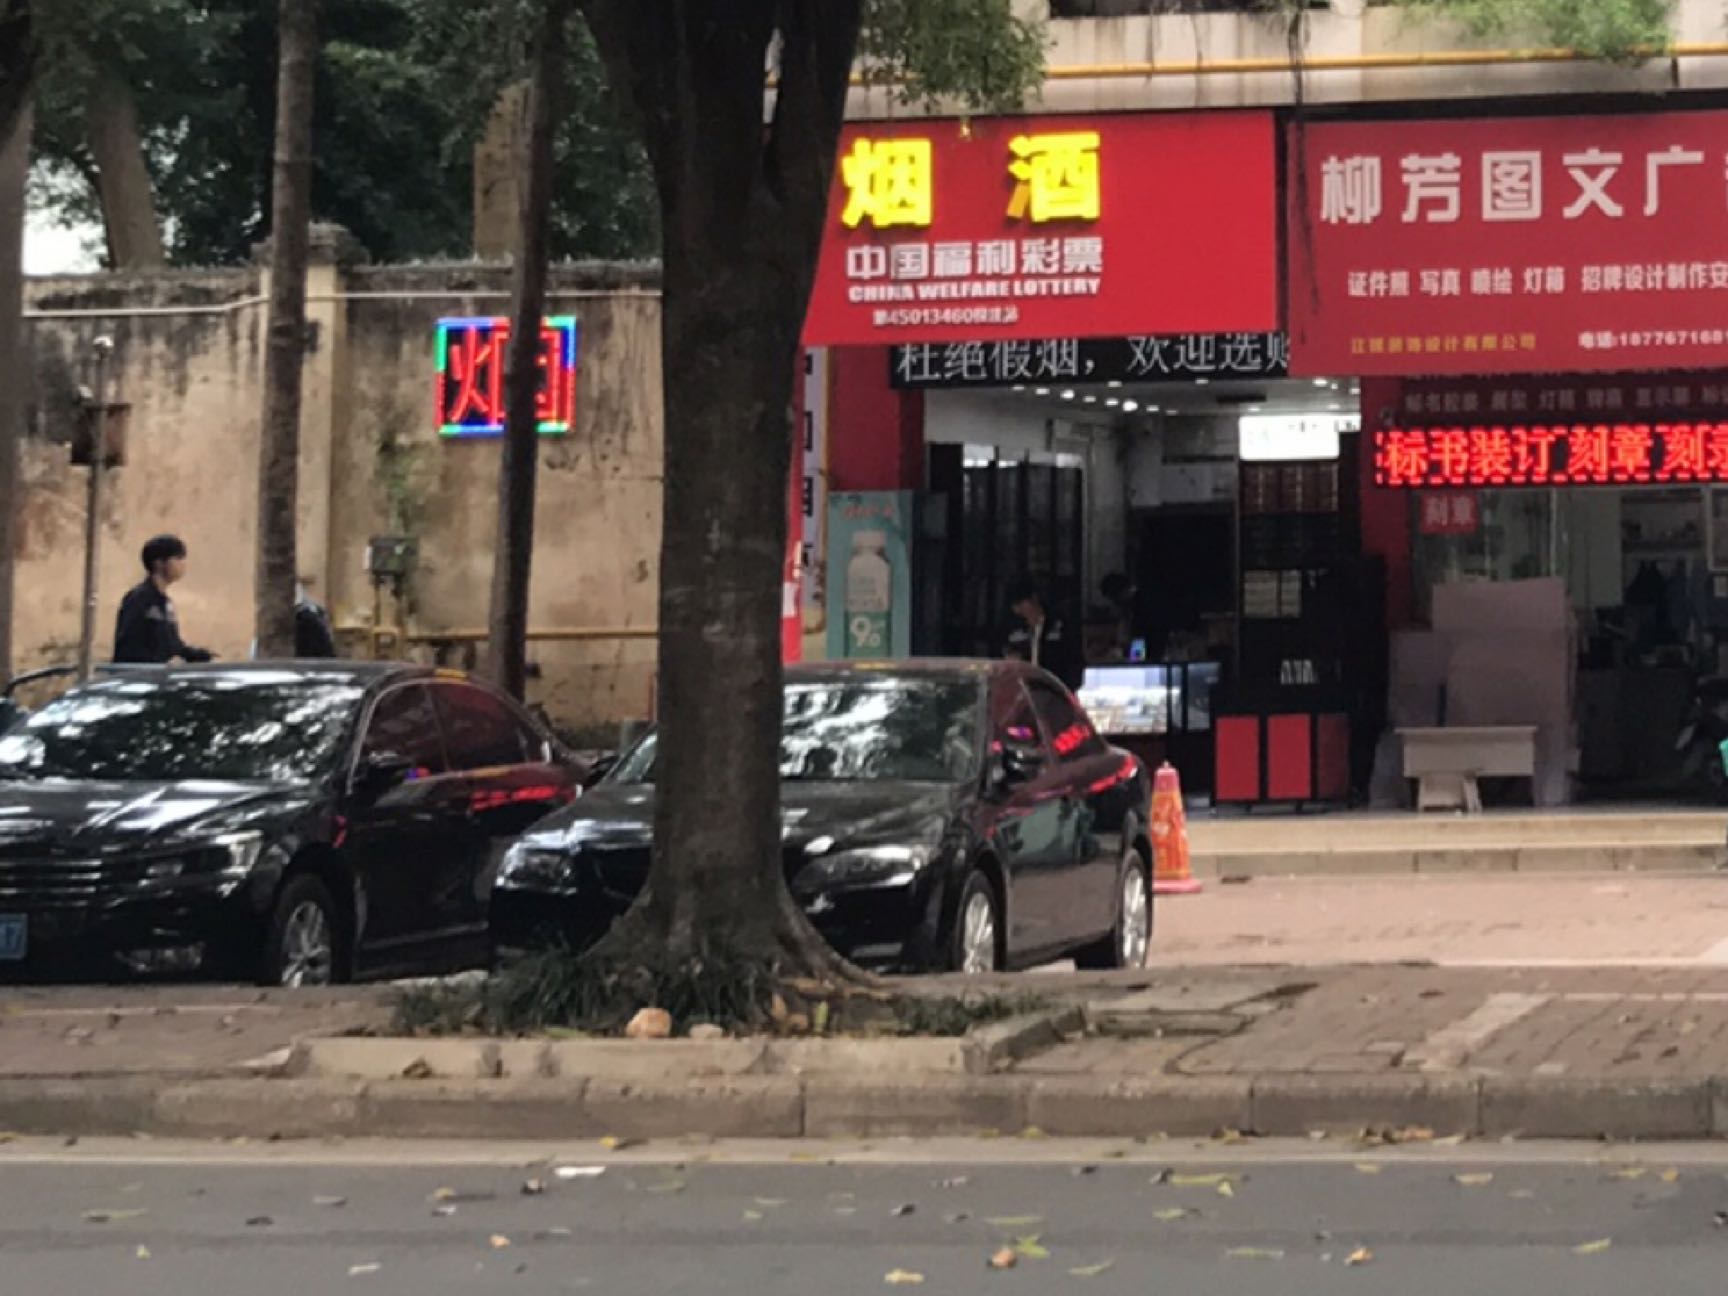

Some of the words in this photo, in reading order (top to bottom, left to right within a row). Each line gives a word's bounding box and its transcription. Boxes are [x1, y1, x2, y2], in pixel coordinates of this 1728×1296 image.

[847, 237, 1102, 280] 中国福利彩票
[849, 282, 914, 302] CHINA
[918, 279, 1009, 301] WELFARE
[1013, 277, 1100, 298] LOTTERY
[1420, 268, 1460, 296] 写真
[1523, 266, 1564, 294] 灯箱
[1385, 425, 1554, 477] 标书装订
[1567, 424, 1652, 476] 刻章
